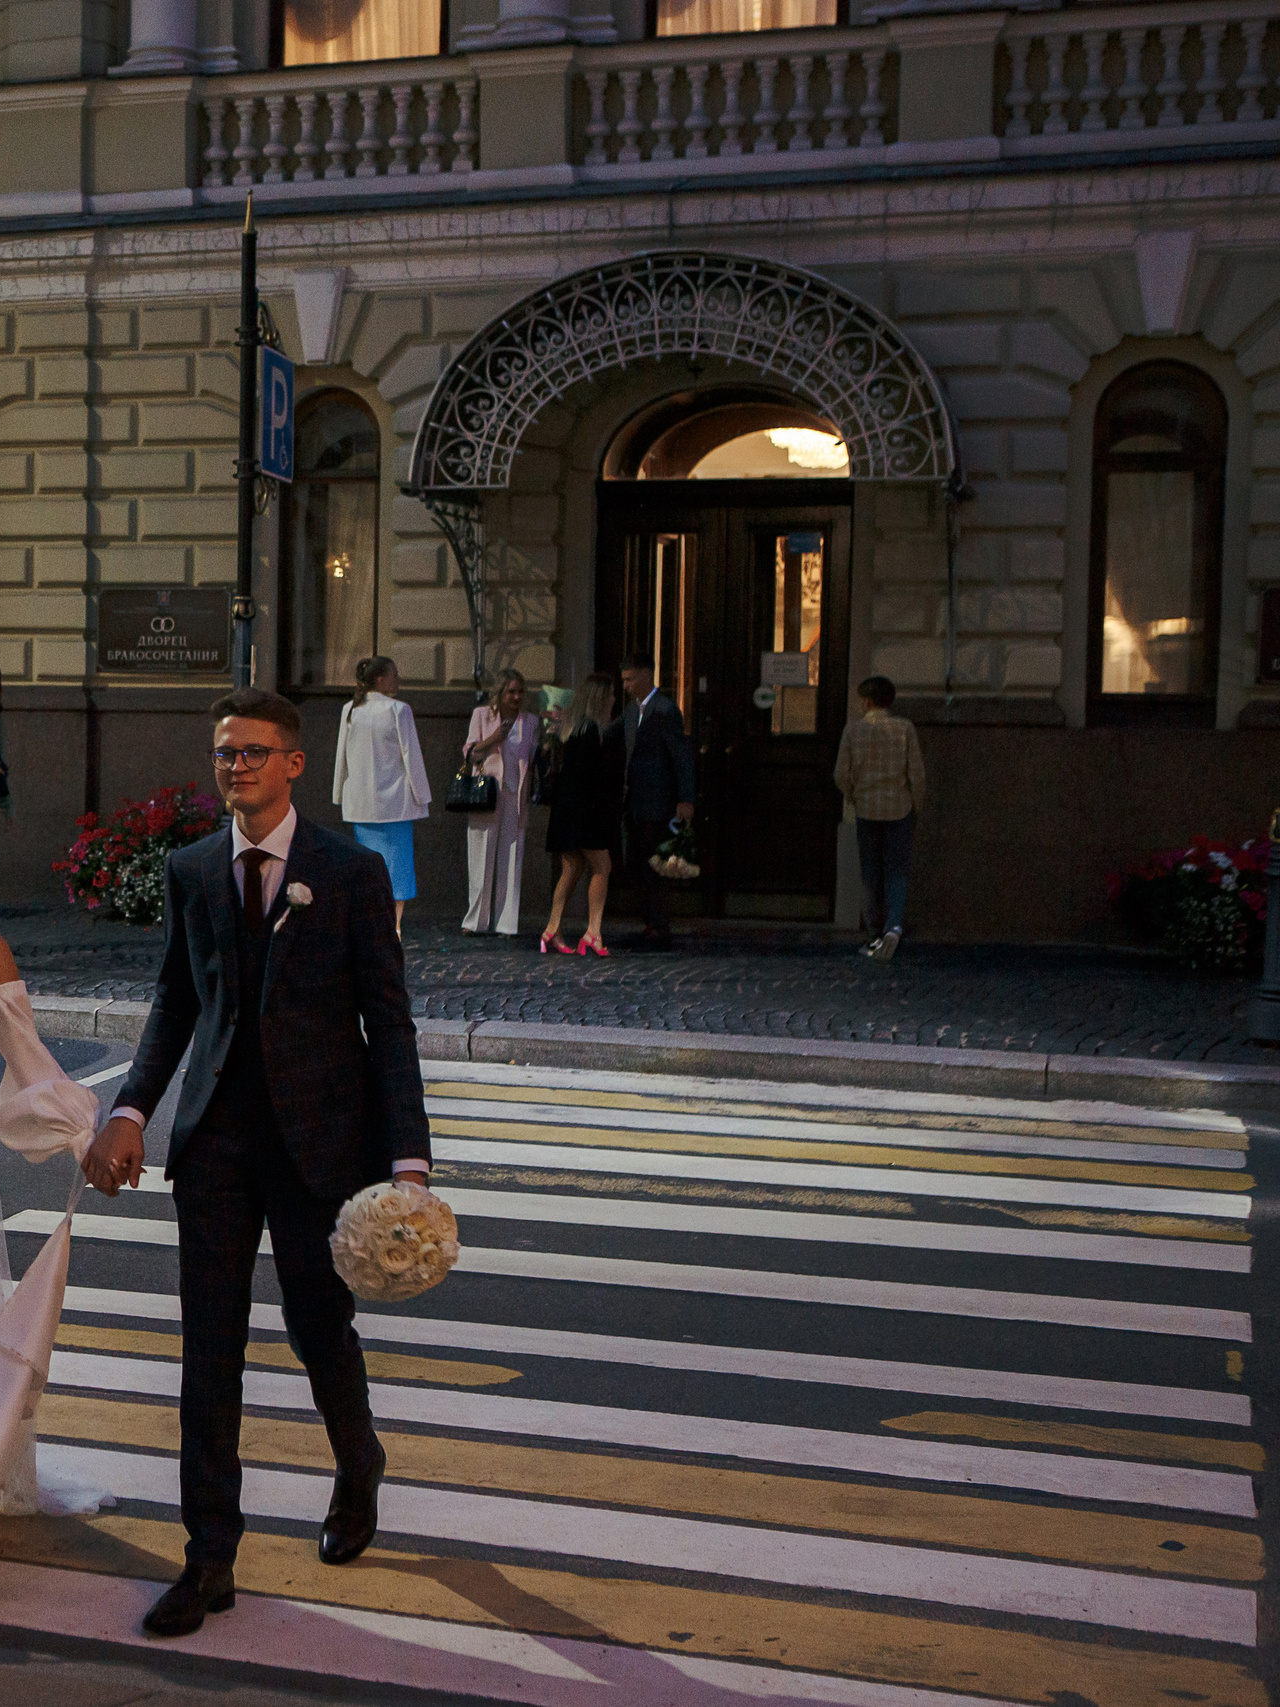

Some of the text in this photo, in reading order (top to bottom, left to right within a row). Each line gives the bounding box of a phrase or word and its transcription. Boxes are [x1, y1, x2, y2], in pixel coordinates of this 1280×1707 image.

[270, 365, 288, 460] P
[137, 635, 187, 647] ДВОРЕЦ
[106, 650, 219, 661] БРАКОСОЧЕТАНИЯ
